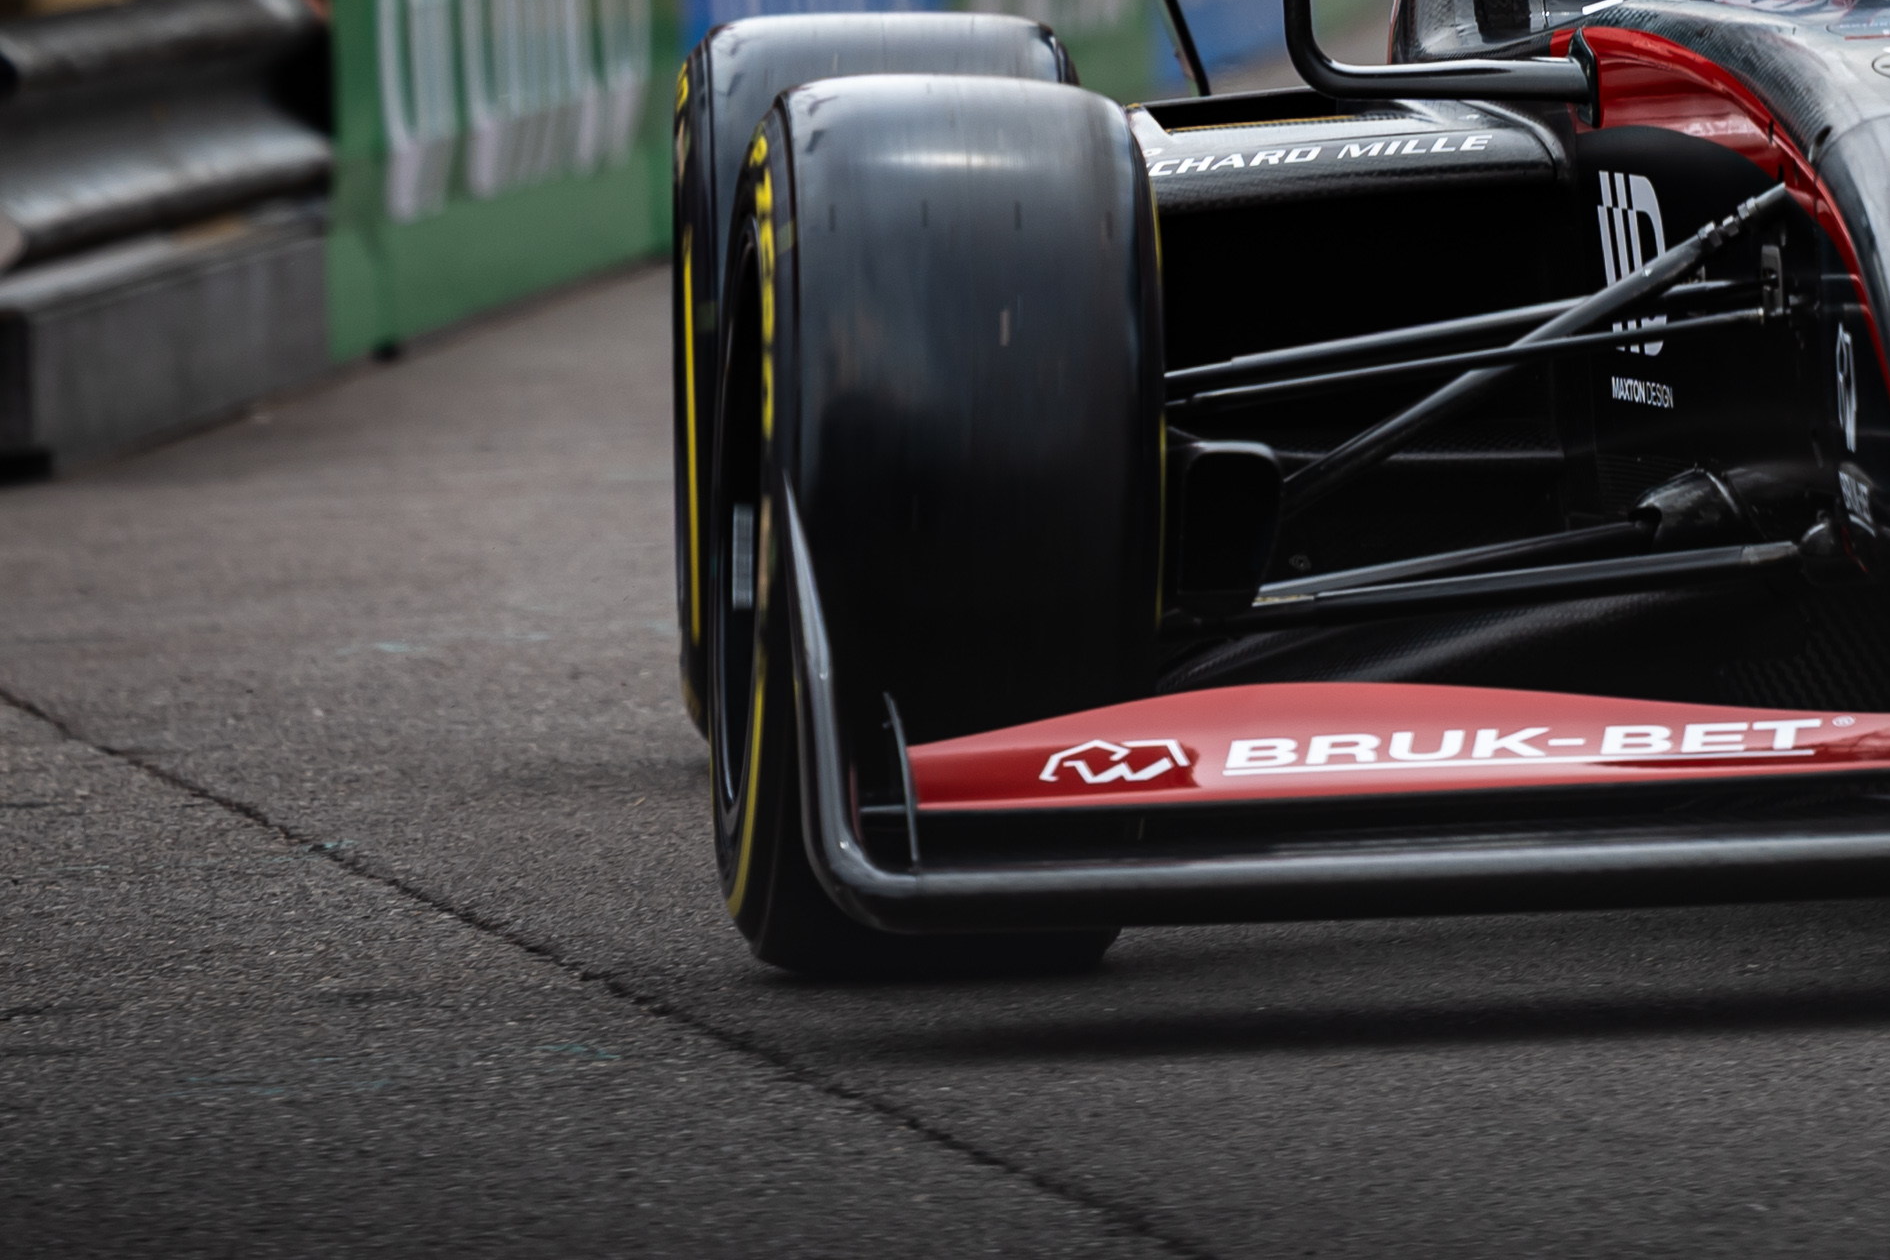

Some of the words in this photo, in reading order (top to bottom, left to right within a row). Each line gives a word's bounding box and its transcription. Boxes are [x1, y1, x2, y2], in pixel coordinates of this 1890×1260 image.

[1147, 145, 1322, 177] CHARD
[1336, 134, 1493, 160] MILLE
[1611, 375, 1645, 404] MAXTON
[1645, 381, 1674, 409] DESIGN
